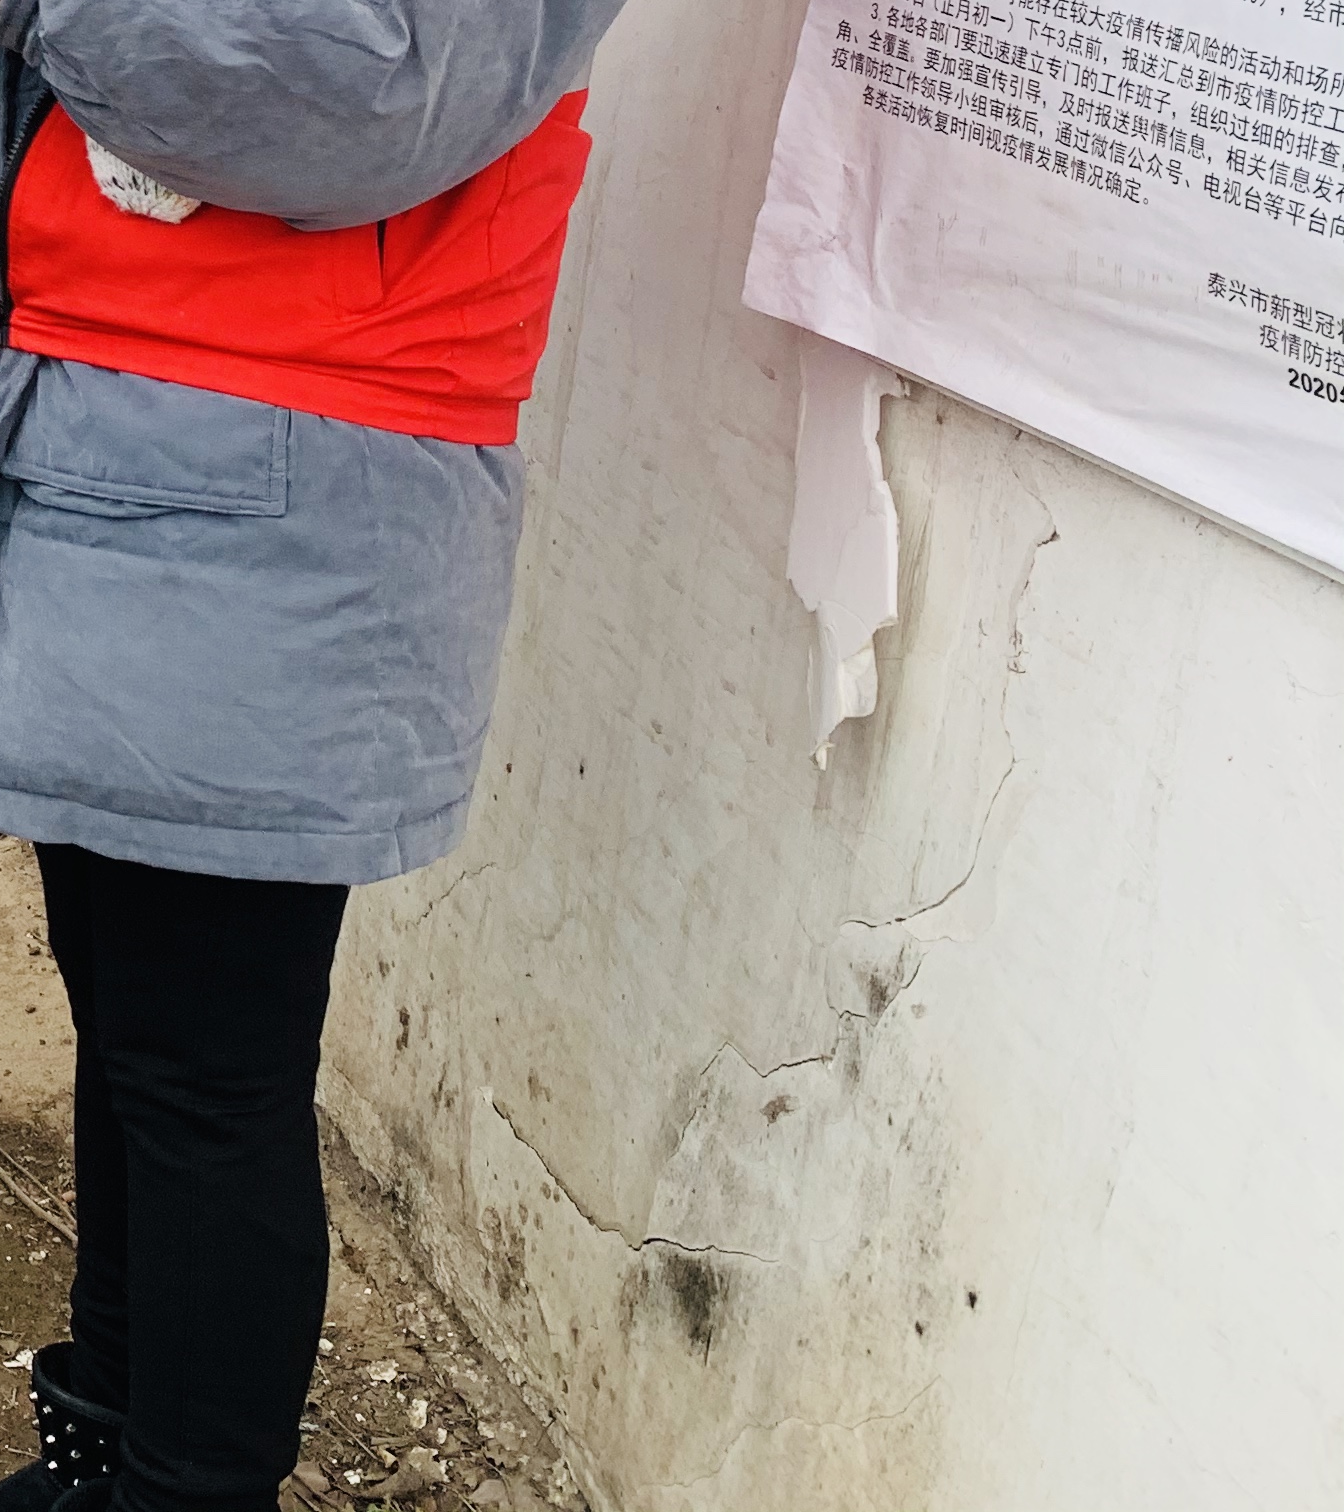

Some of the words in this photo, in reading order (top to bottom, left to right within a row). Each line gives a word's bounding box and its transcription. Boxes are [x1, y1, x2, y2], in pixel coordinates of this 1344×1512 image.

[1259, 324, 1344, 377] 疫情防控
[1287, 367, 1344, 404] 2020
